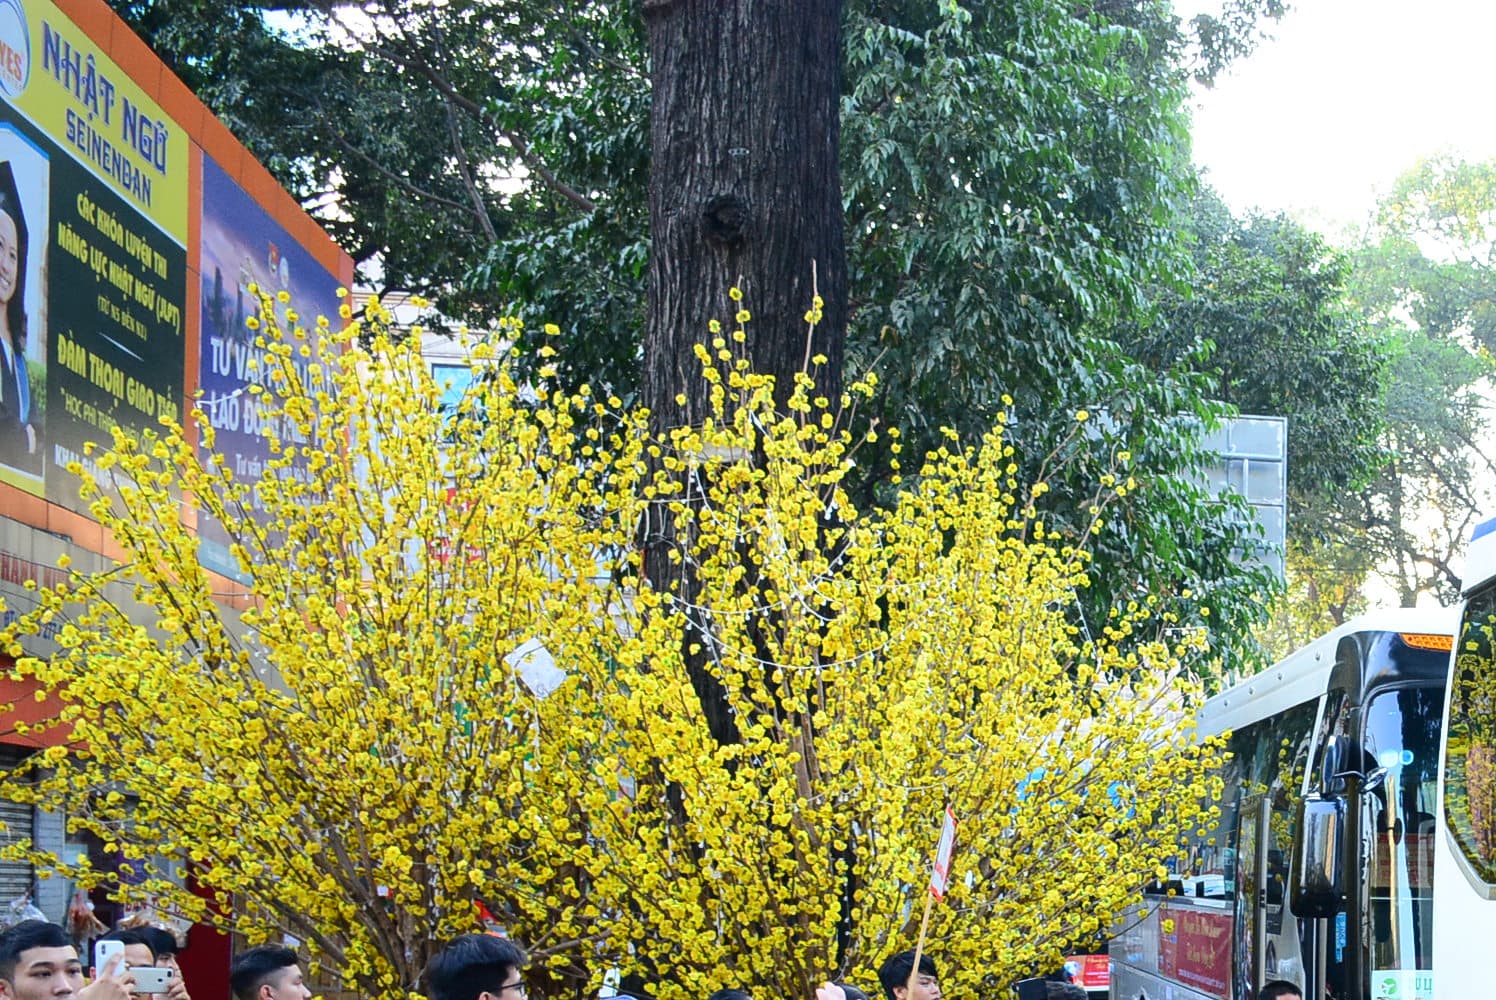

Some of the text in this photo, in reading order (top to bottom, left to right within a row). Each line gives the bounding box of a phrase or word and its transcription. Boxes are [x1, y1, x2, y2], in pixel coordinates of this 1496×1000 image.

[42, 20, 168, 176] NHẬT NGỮ
[57, 330, 87, 378] ĐÀM
[89, 352, 124, 407] THOẠI
[126, 377, 154, 416] GIAO
